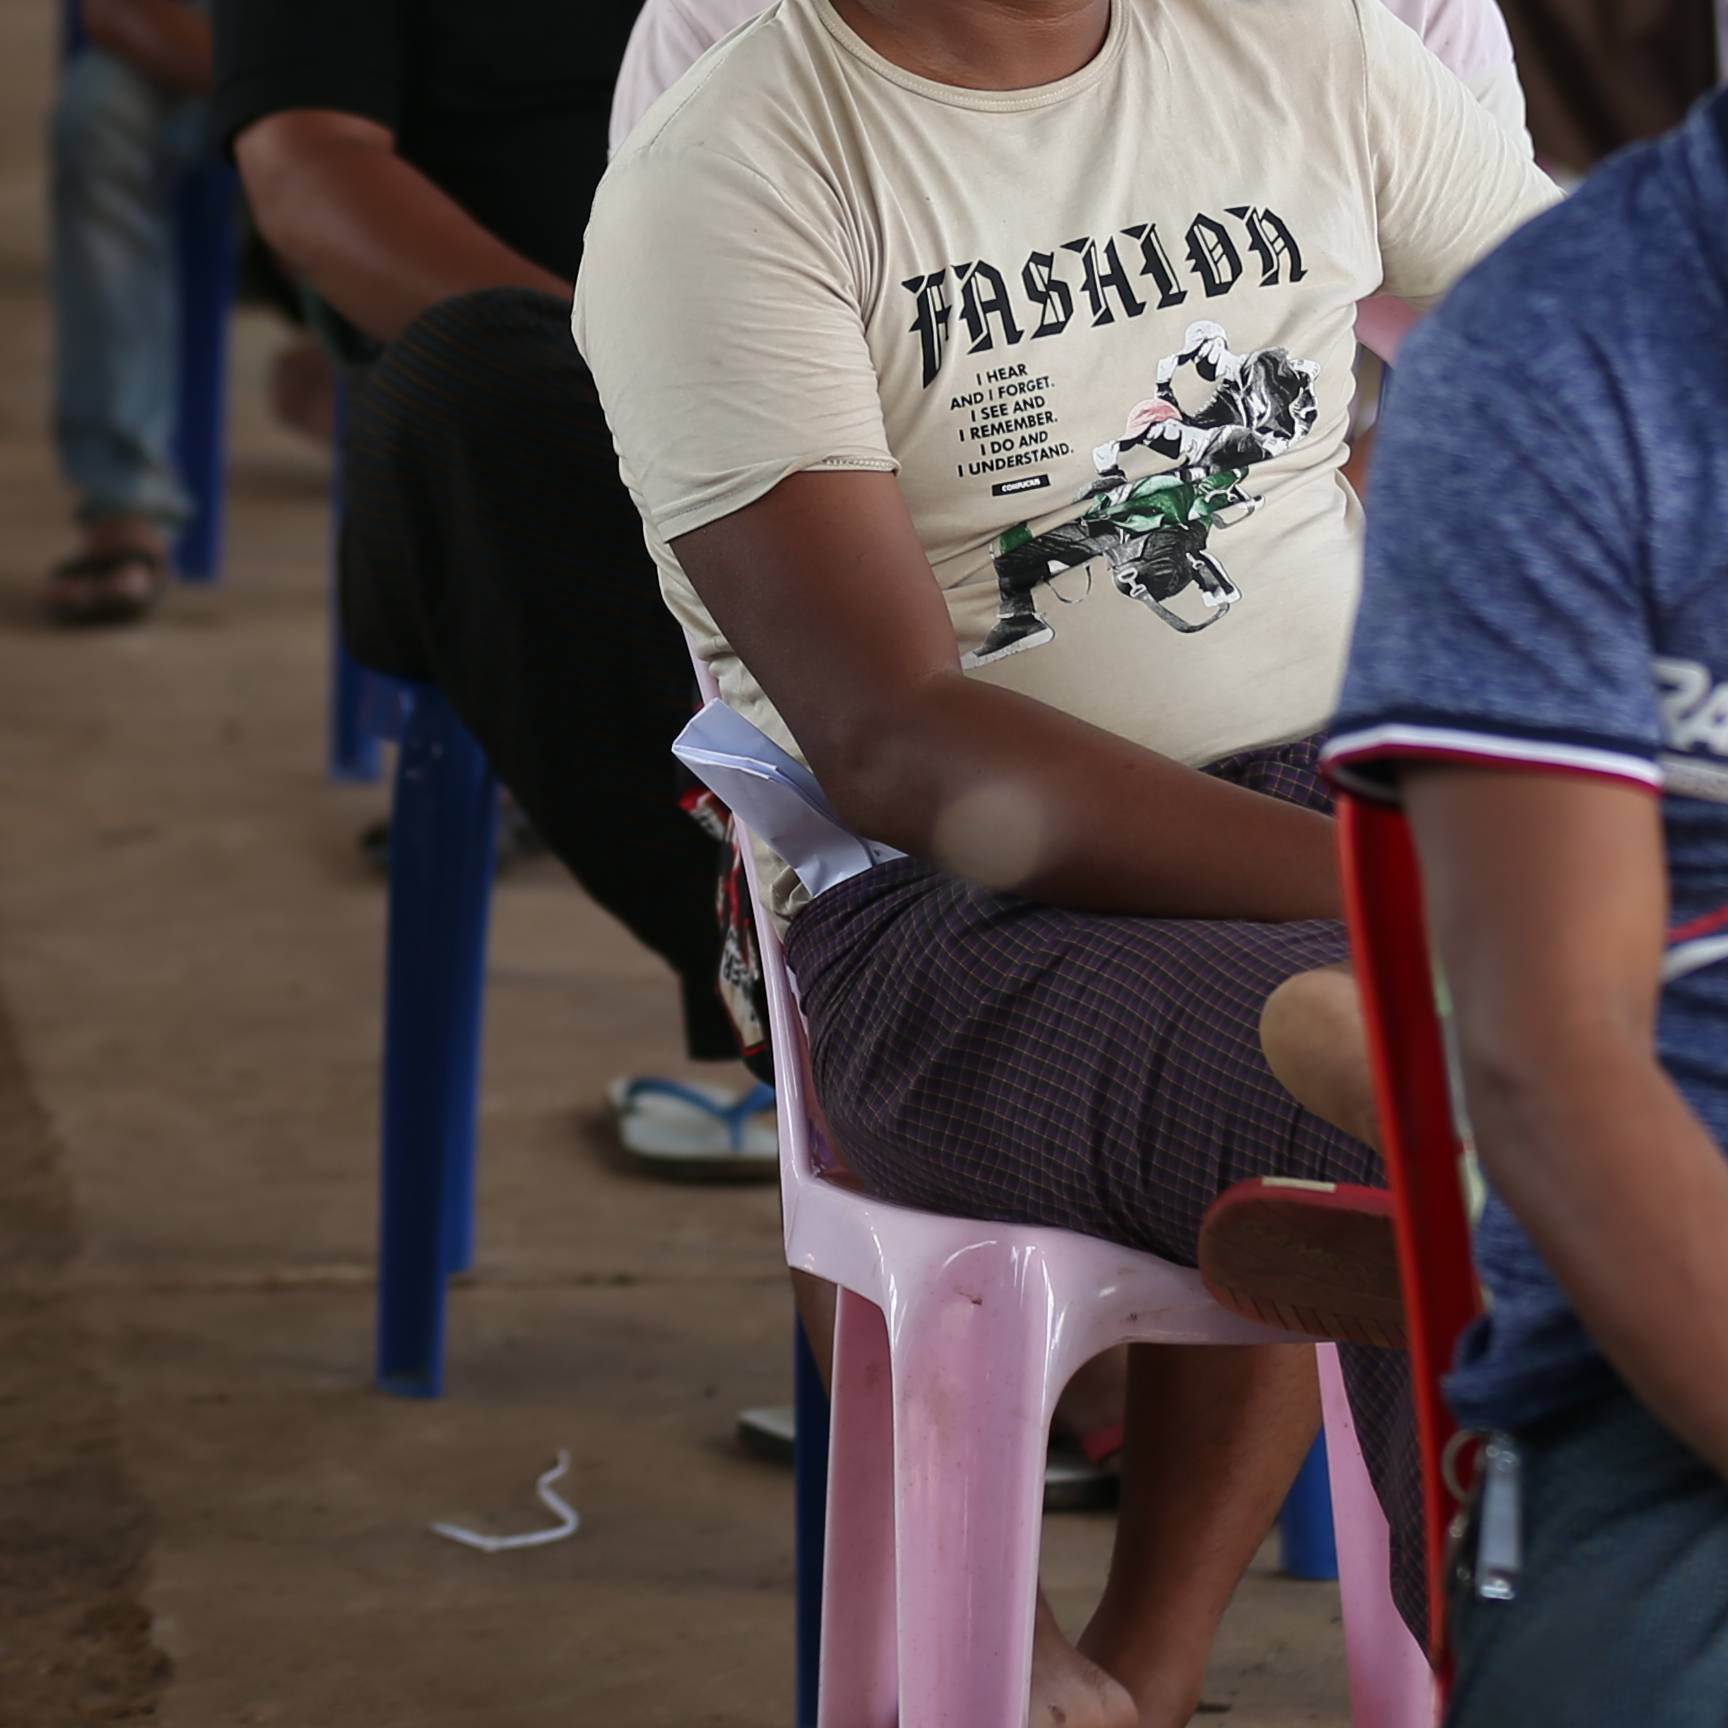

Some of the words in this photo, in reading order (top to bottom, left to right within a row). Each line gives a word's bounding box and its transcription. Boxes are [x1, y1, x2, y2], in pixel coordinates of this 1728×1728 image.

[900, 205, 1309, 390] FASHION
[976, 373, 981, 386] I
[986, 363, 1028, 384] HEAR
[950, 391, 984, 411] AND
[988, 389, 993, 401] I
[997, 375, 1055, 399] FORGET.
[971, 409, 976, 422] I
[980, 403, 1008, 420] SEE
[1012, 395, 1046, 414] AND
[959, 429, 964, 442] I
[970, 410, 1058, 440] REMEMBER.
[980, 443, 986, 456] I
[990, 438, 1014, 454] DO
[1019, 430, 1048, 448] AND
[958, 465, 963, 477] I
[969, 442, 1074, 475] UNDERSTAND.
